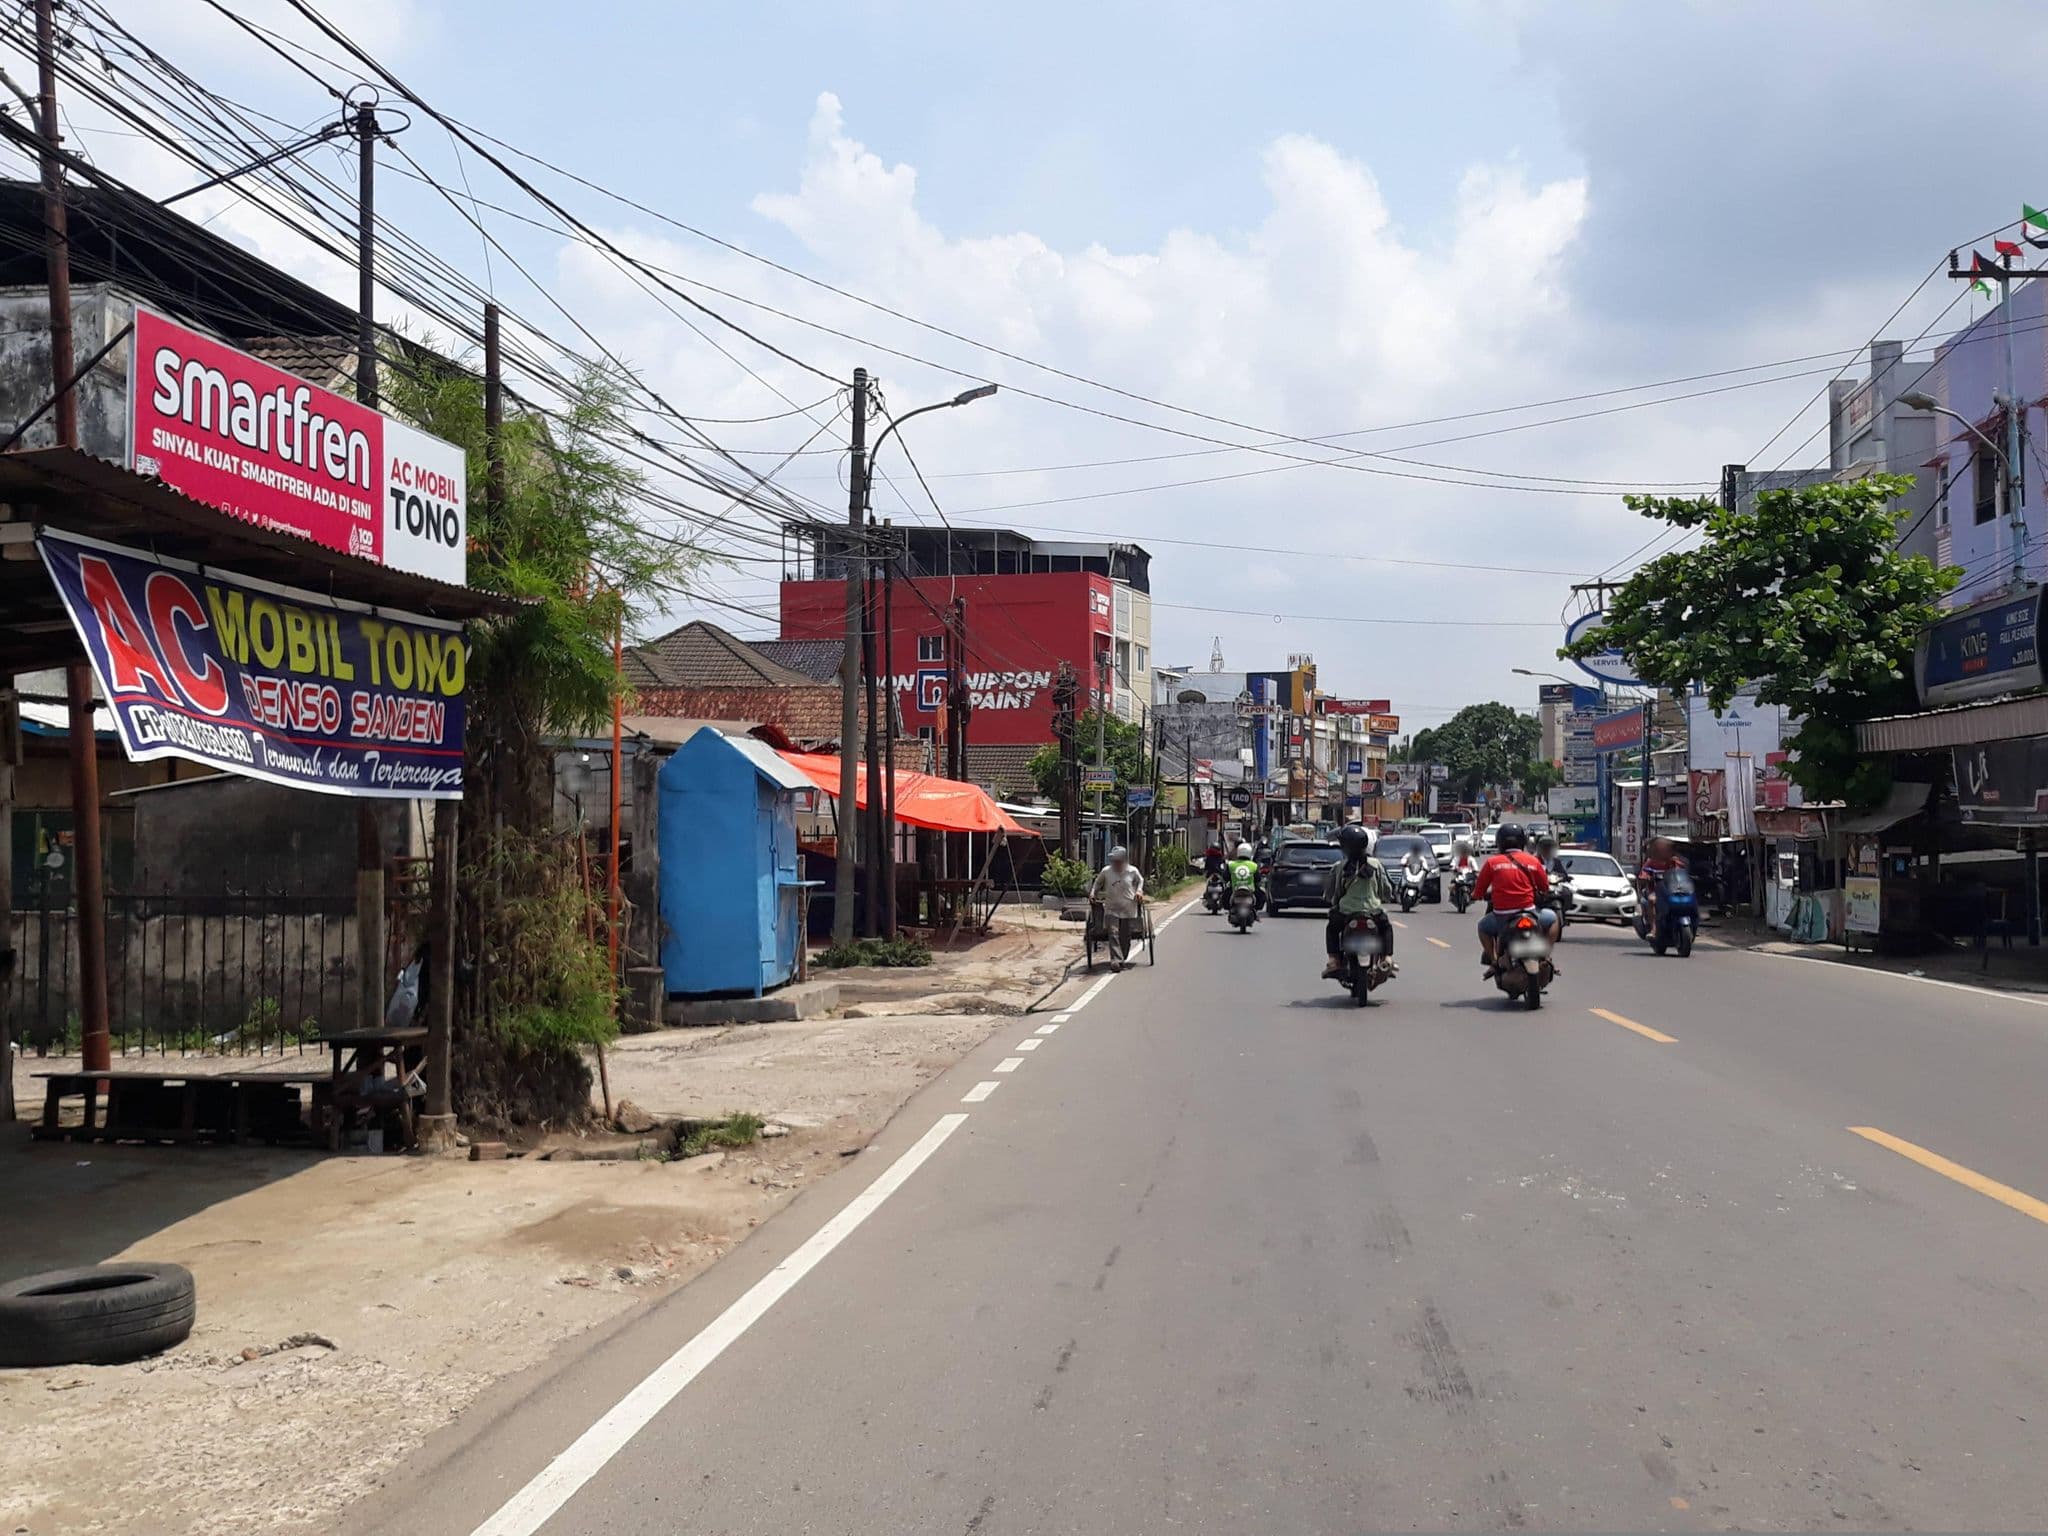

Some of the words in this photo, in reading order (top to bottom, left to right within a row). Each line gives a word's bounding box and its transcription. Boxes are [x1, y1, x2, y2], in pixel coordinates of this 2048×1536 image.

[152, 346, 371, 490] smartfren
[152, 427, 203, 463] SINYAL
[204, 446, 240, 475] KUAT
[240, 460, 312, 500] SMARTFREN
[313, 485, 337, 510] ADA
[338, 495, 350, 513] DI
[350, 500, 372, 520] SINI
[390, 457, 412, 486] AC
[415, 464, 459, 505] MOBIL
[390, 487, 460, 548] TONO
[78, 553, 229, 717] AC
[206, 585, 355, 682] MOBIL
[359, 619, 468, 697] TONO
[1961, 631, 1988, 657] KING
[241, 674, 342, 735] DENSO
[965, 670, 1052, 691] NIPPON
[968, 690, 1036, 710] PAINT
[1244, 706, 1275, 714] APOTIK
[1377, 718, 1397, 729] JOTUN
[1716, 720, 1752, 728] Valvoline
[252, 731, 324, 779] Termurah
[328, 760, 360, 782] dan
[364, 750, 464, 792] Terpercaya
